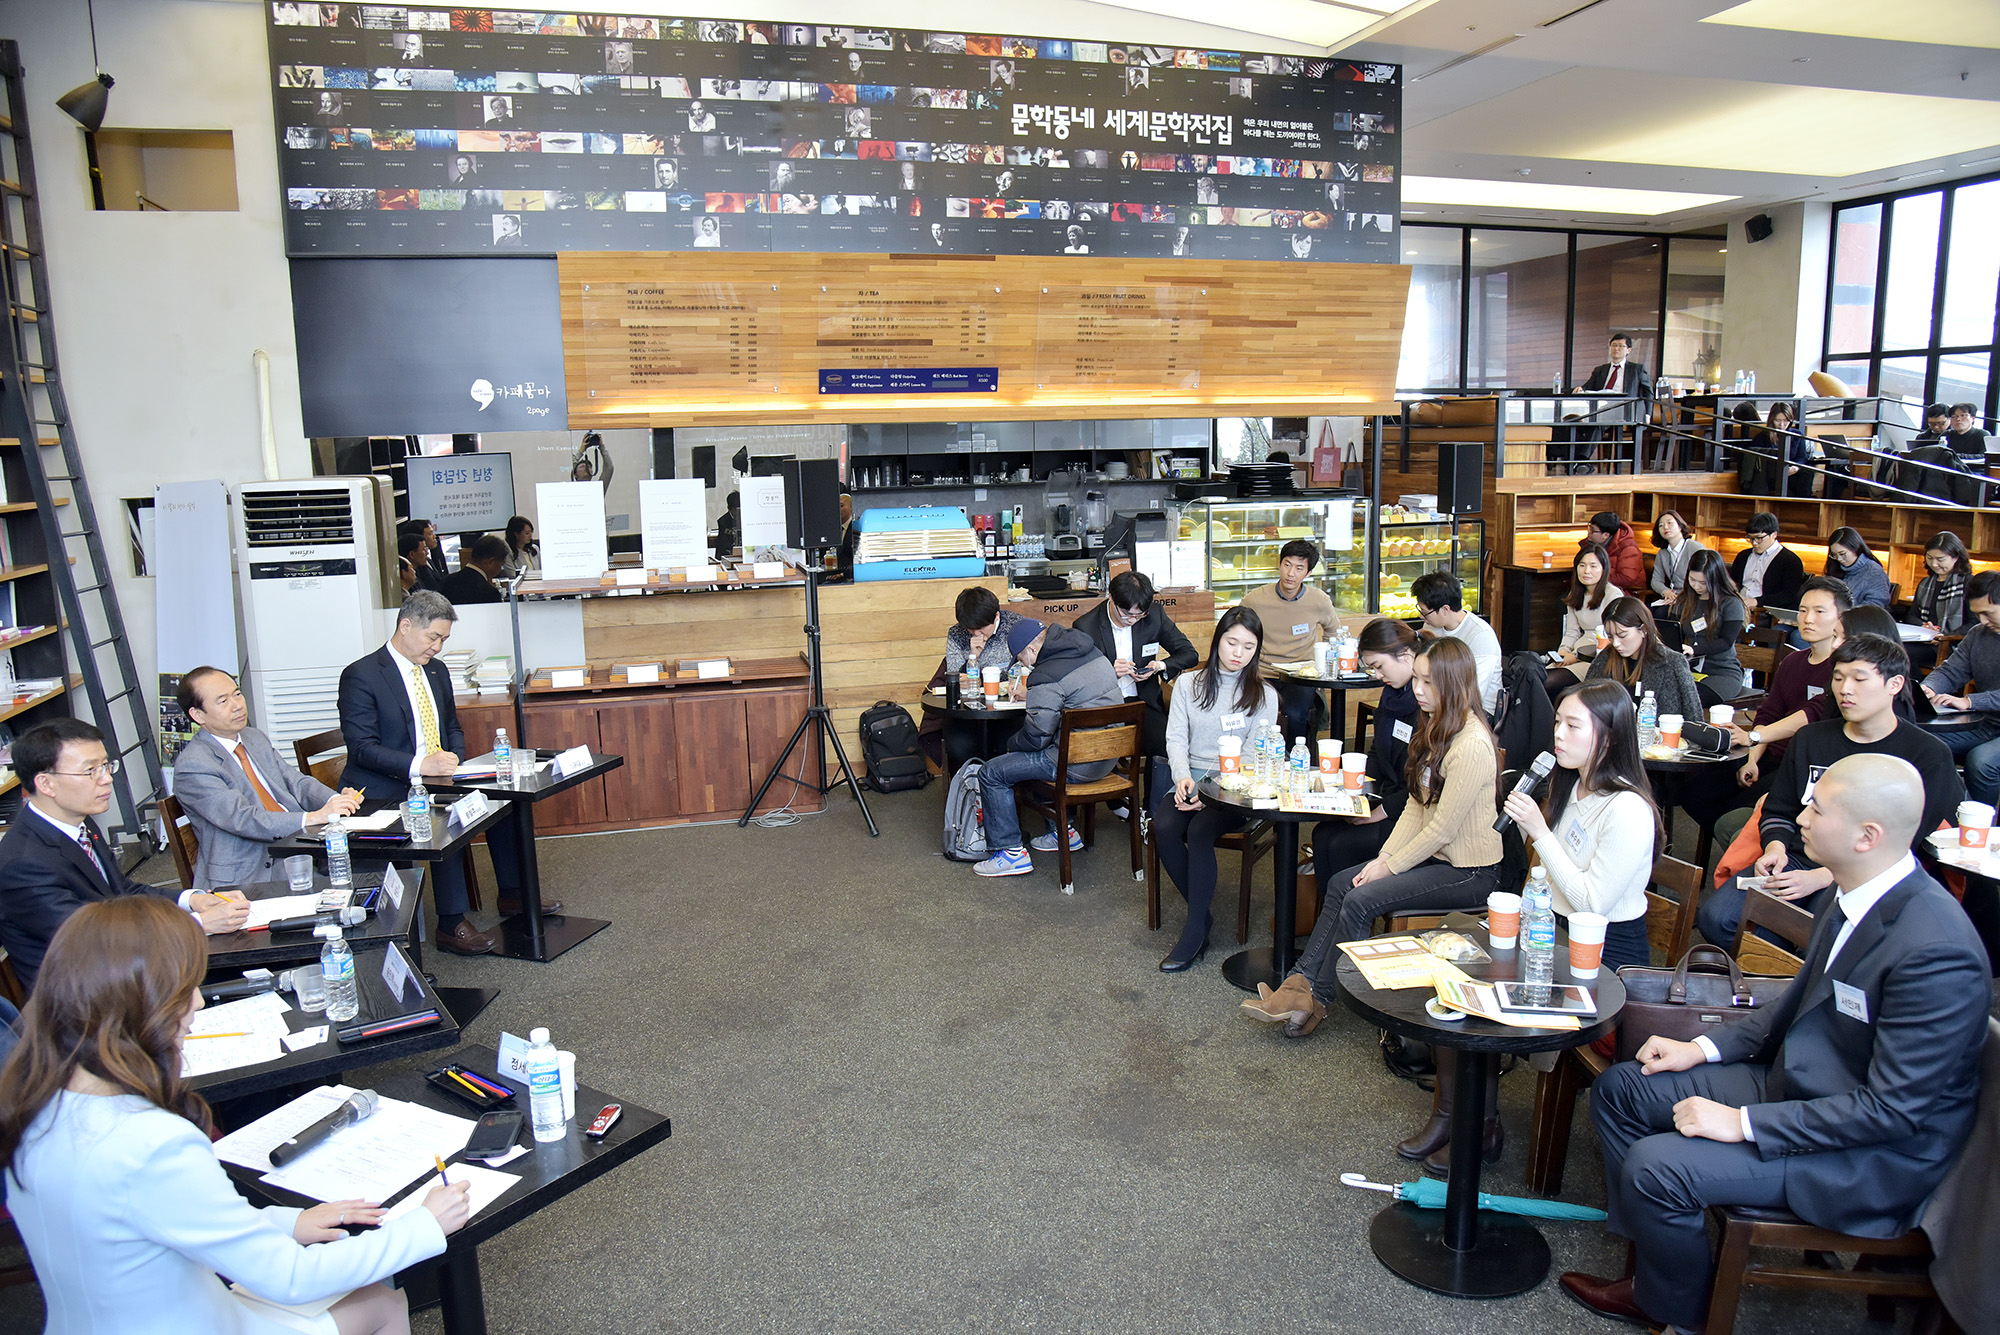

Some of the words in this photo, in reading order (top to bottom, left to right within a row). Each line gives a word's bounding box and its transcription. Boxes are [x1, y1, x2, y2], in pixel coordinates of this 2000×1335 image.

[1010, 103, 1095, 140] 문학동네
[1103, 108, 1233, 146] 세계문학전집
[1257, 119, 1270, 128] 우리
[1270, 120, 1289, 129] 내면의
[1243, 128, 1262, 138] 바다를
[496, 382, 552, 400] 카페꼼마
[526, 406, 550, 416] 2page
[1044, 605, 1064, 613] PICK
